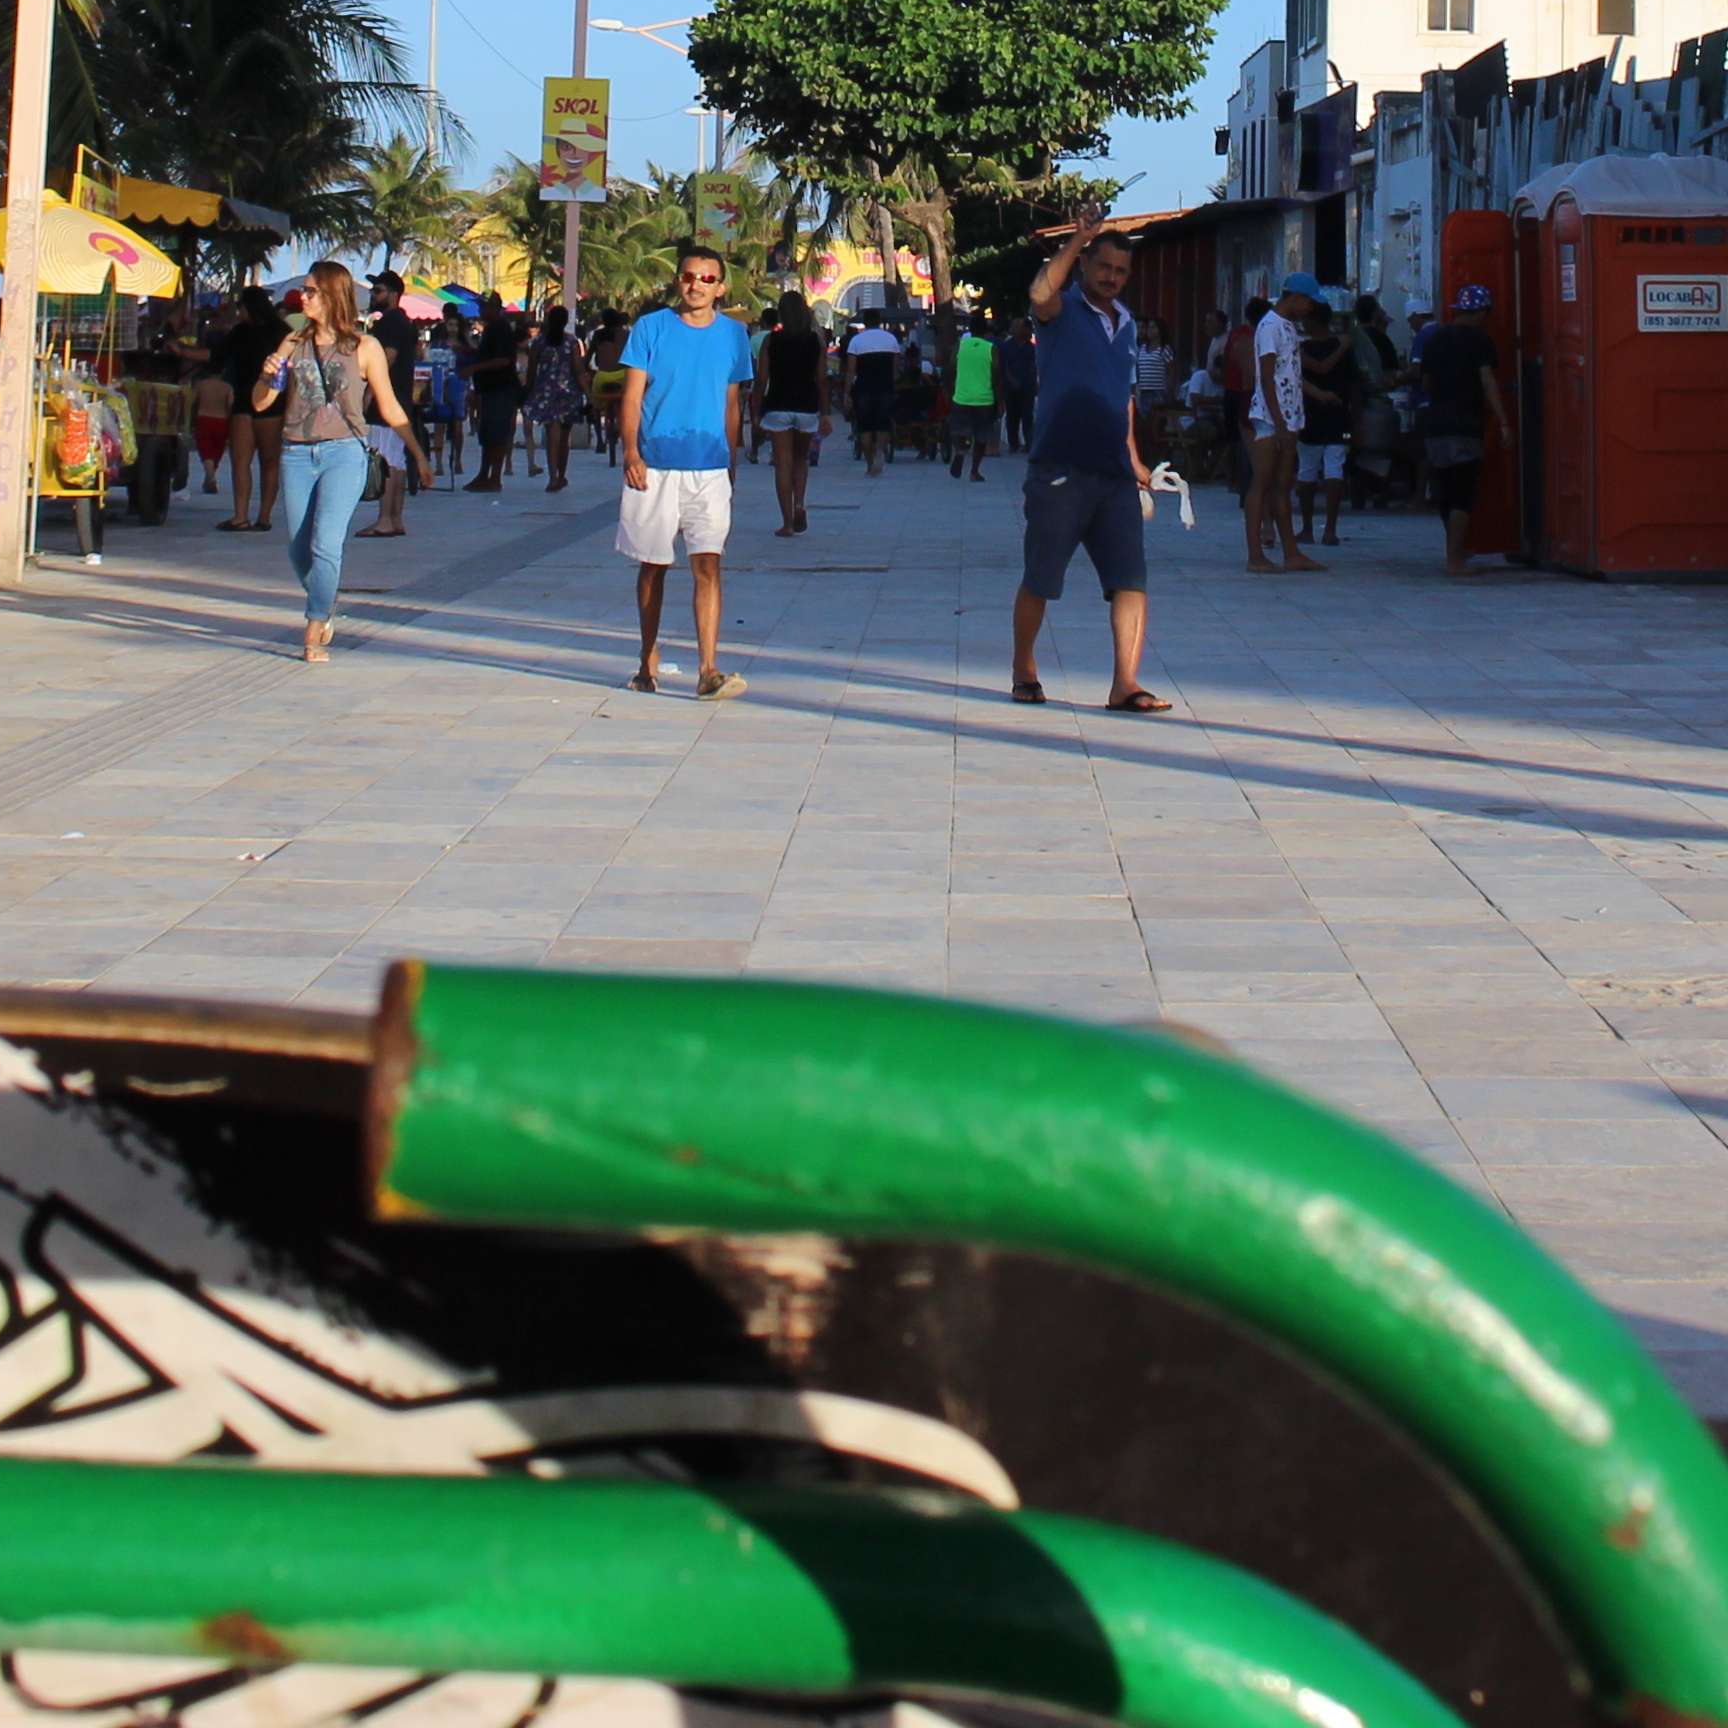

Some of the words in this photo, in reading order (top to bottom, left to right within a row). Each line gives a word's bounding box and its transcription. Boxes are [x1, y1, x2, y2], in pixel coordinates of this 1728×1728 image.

[553, 97, 600, 115] SKOL
[703, 182, 733, 194] SKOL
[1649, 286, 1714, 305] LOCABAN
[1644, 316, 1664, 326] (85)
[1694, 316, 1720, 327] 7474
